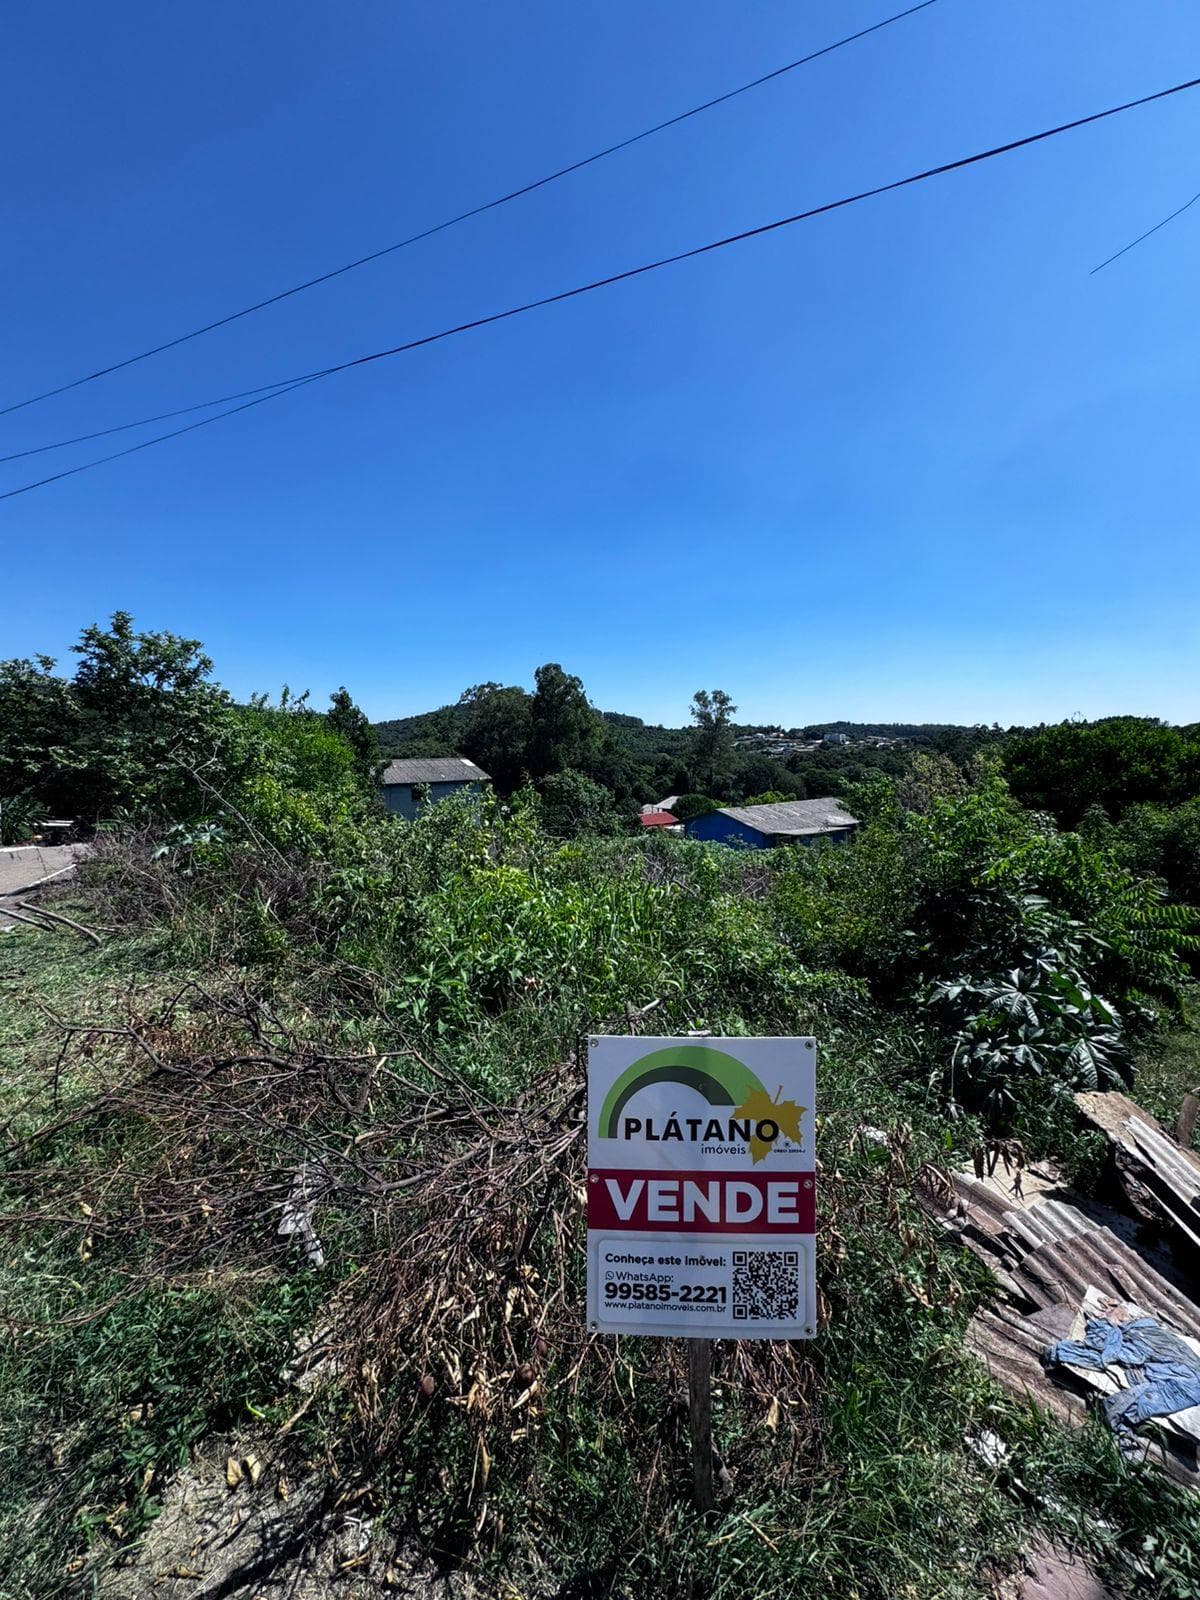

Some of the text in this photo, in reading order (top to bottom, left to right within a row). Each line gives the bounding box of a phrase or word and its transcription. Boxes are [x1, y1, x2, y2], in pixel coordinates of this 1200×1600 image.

[624, 1111, 780, 1143] PLÁTANO
[701, 1143, 746, 1155] imóveis
[604, 1179, 800, 1224] VENDE
[605, 1253, 655, 1266] Conheça
[658, 1255, 682, 1265] este
[616, 1270, 674, 1284] WhatsApp:
[604, 1282, 727, 1304] 99585-2221
[604, 1301, 727, 1313] www.platanoimoveis.com.br
